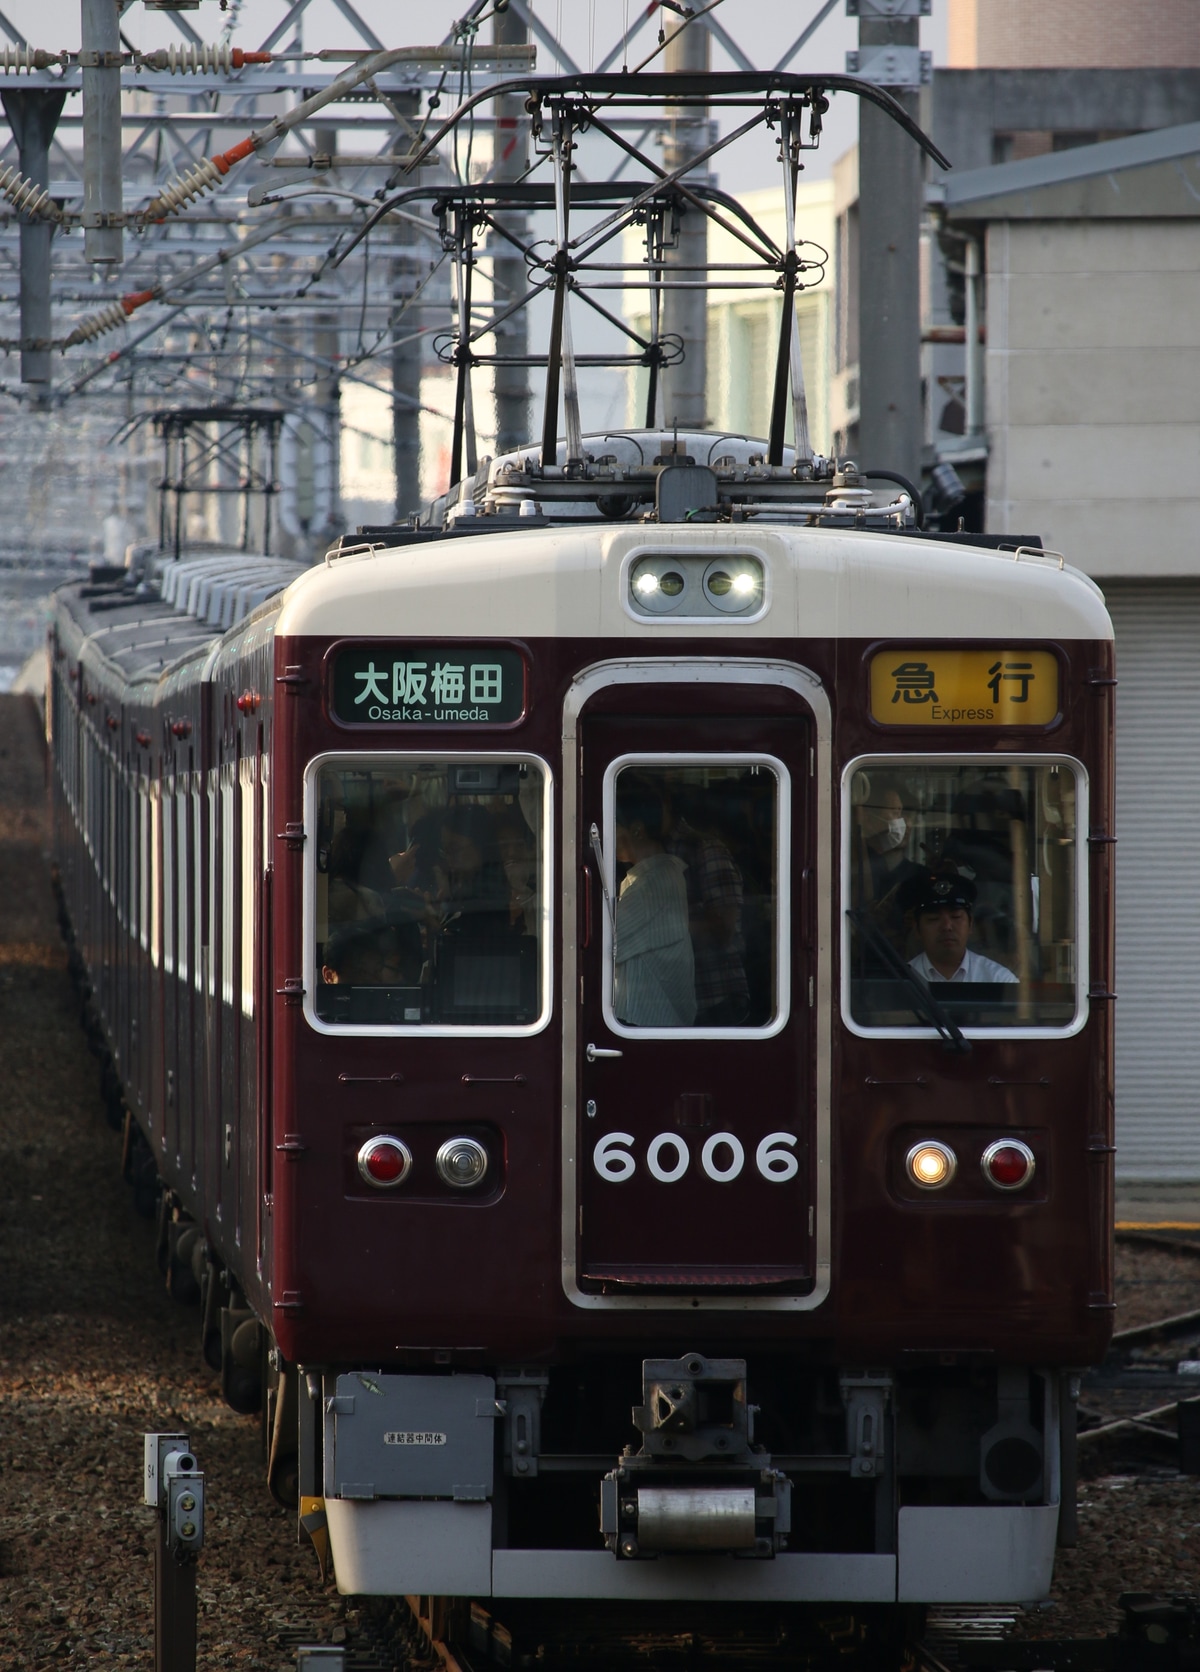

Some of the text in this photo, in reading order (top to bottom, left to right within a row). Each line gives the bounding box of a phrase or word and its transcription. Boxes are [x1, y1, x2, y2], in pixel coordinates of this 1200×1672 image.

[354, 661, 502, 705] 大阪梅田
[891, 661, 1035, 704] 急行
[368, 705, 489, 721] Osaka-umeda
[932, 705, 994, 722] Express
[593, 1131, 799, 1183] 6006
